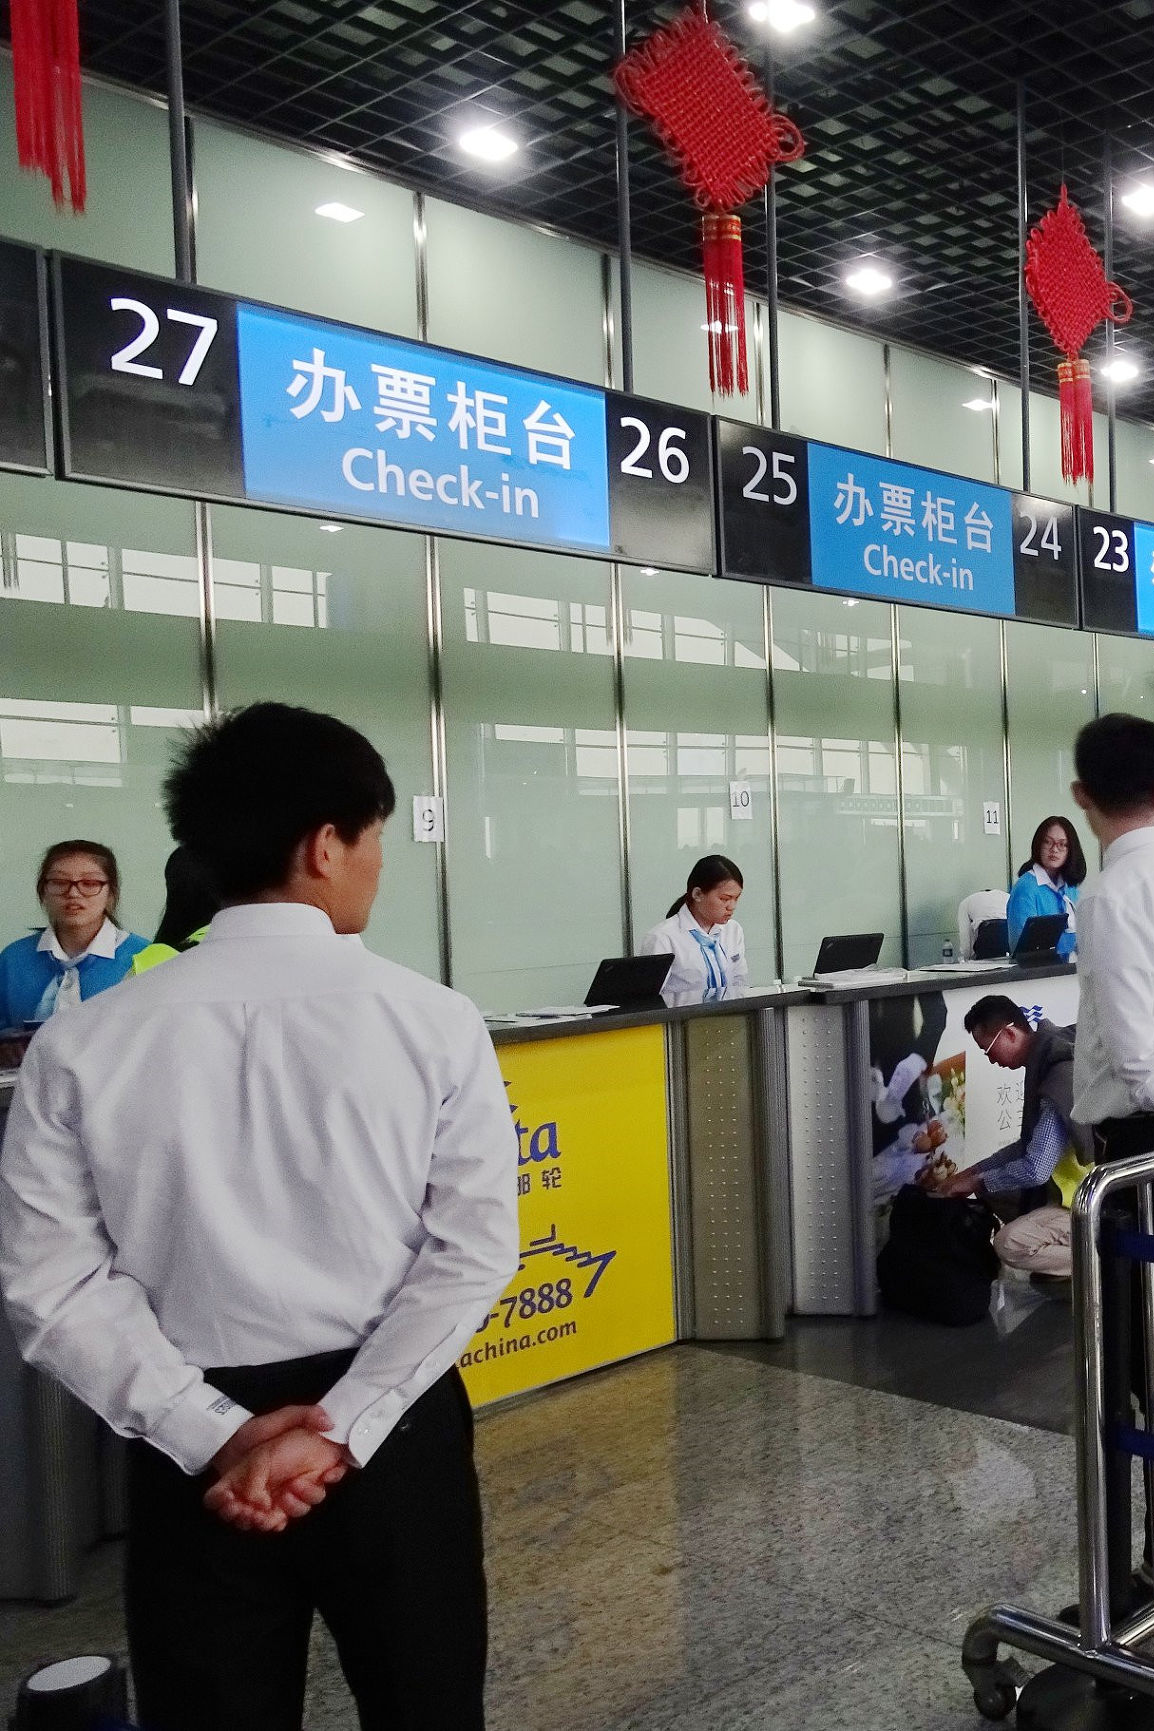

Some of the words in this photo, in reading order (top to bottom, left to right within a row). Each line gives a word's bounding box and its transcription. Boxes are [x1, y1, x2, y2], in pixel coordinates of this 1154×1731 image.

[110, 297, 219, 387] 27
[285, 347, 576, 471] 办票柜台
[618, 415, 690, 485] 26
[741, 445, 798, 506] 25
[341, 446, 540, 520] Check-in
[833, 472, 995, 554] 办票柜台
[1019, 510, 1062, 561] 24
[863, 543, 974, 591] Check-in
[1093, 525, 1130, 573] 23
[421, 808, 436, 832] 9
[731, 790, 750, 809] 10
[986, 809, 999, 825] 11
[456, 1320, 578, 1369] achina.com
